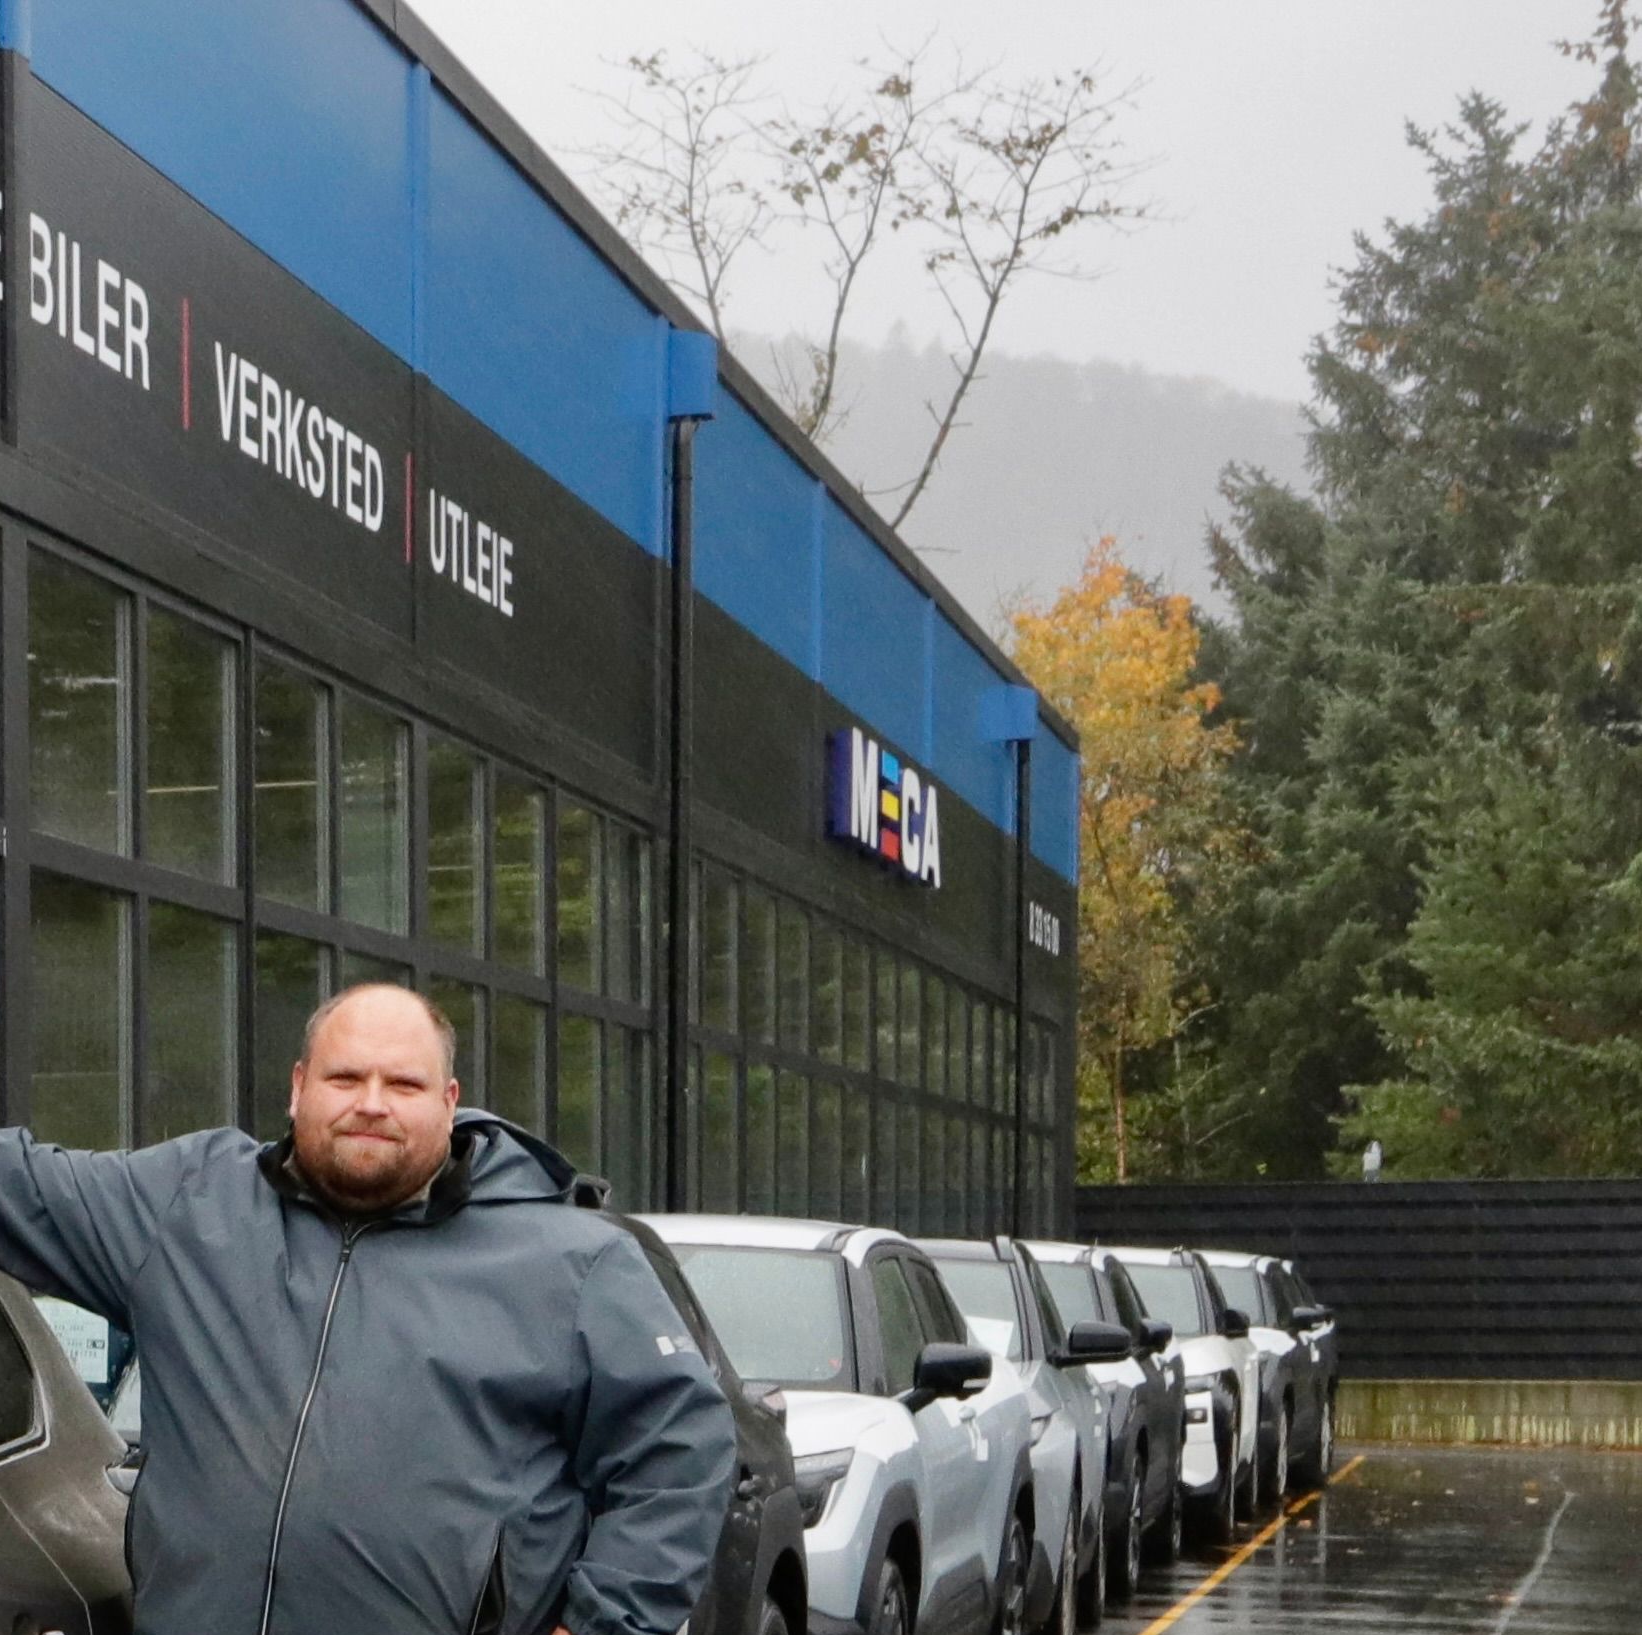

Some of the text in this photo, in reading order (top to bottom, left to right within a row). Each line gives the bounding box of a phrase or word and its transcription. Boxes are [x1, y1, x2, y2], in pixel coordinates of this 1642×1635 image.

[29, 212, 150, 390] BILER
[215, 341, 384, 532] VERKSTED
[429, 488, 513, 617] UTLEIE
